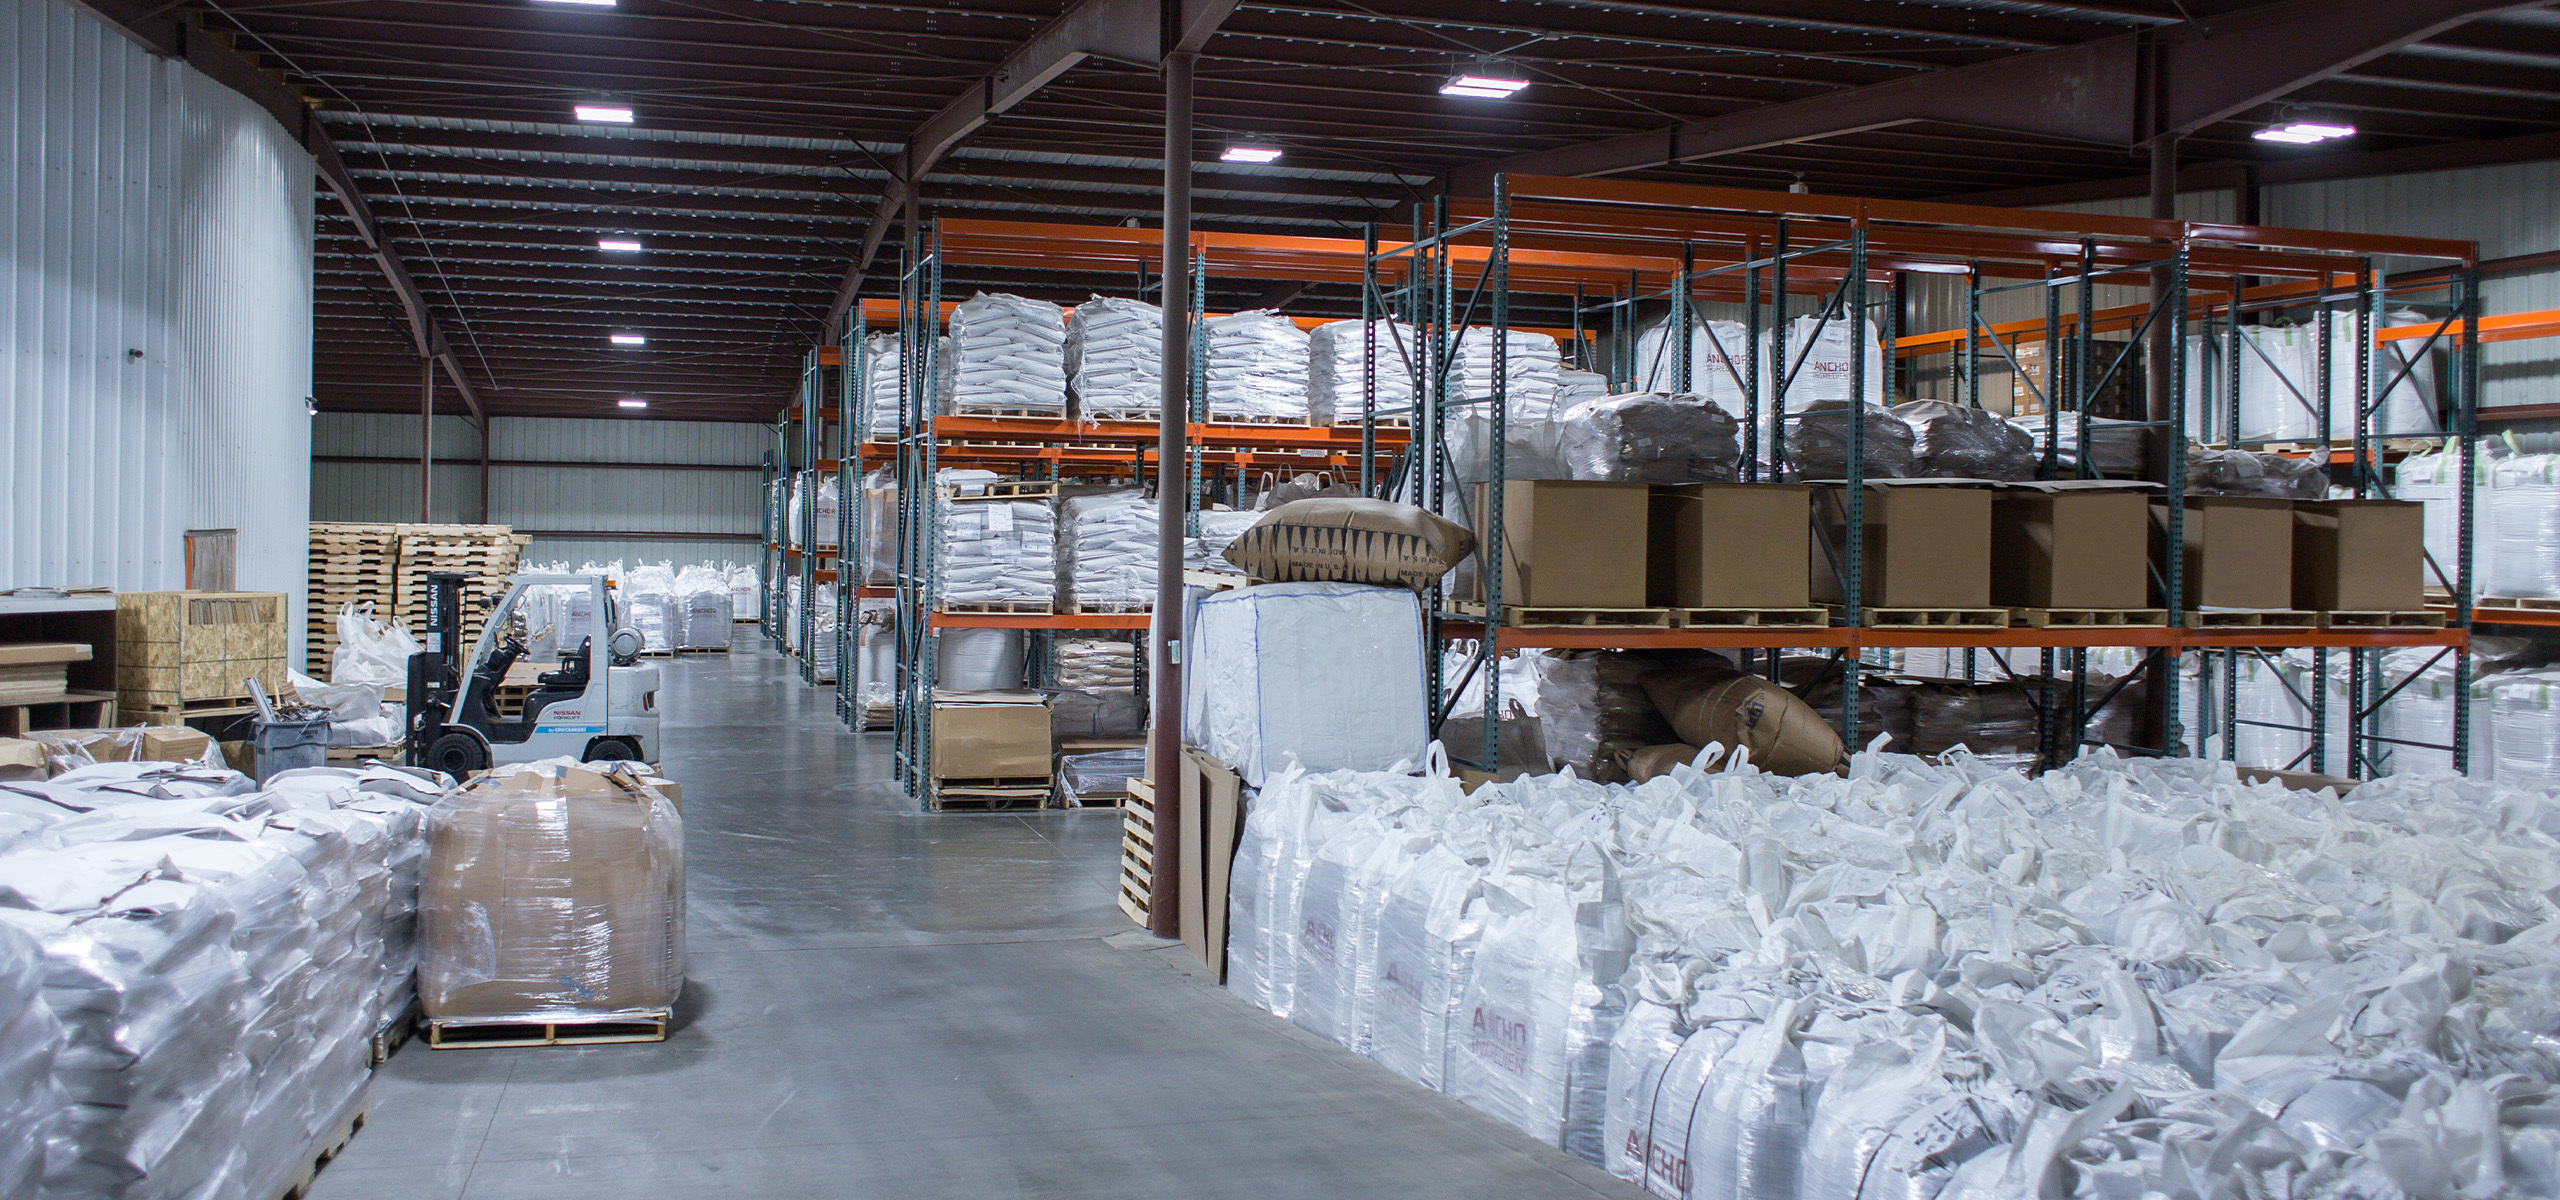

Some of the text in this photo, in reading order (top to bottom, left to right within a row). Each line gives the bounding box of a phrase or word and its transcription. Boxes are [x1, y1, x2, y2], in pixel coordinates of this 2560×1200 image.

[1813, 360, 1849, 372] ANCHO
[1291, 561, 1314, 569] MADE
[1400, 570, 1424, 578] MADE
[430, 584, 439, 627] NISSAN
[1624, 1128, 1694, 1194] ACHO
